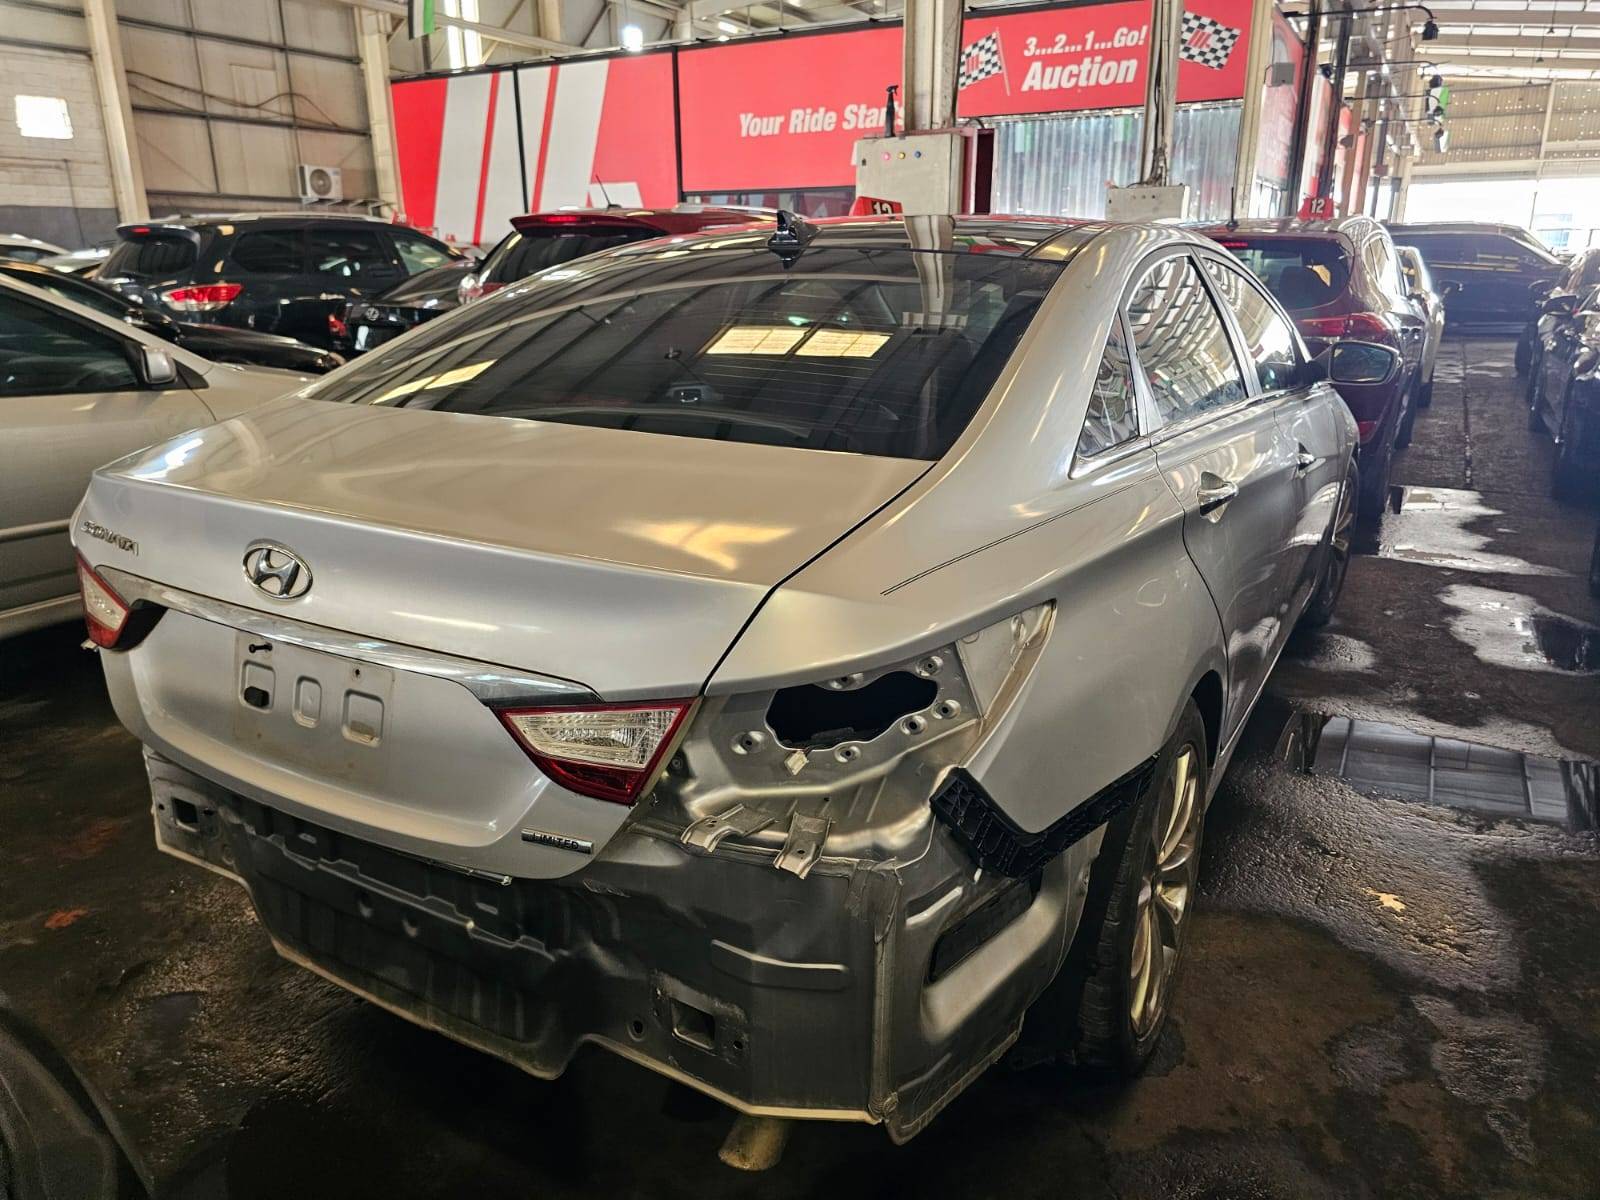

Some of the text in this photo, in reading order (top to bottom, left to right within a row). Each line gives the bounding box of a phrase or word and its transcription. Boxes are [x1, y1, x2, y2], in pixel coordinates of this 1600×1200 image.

[1020, 55, 1139, 92] Auction
[739, 112, 785, 138] Your
[788, 106, 837, 134] Ride
[1311, 198, 1326, 214] 12
[530, 831, 580, 850] LIMITED
